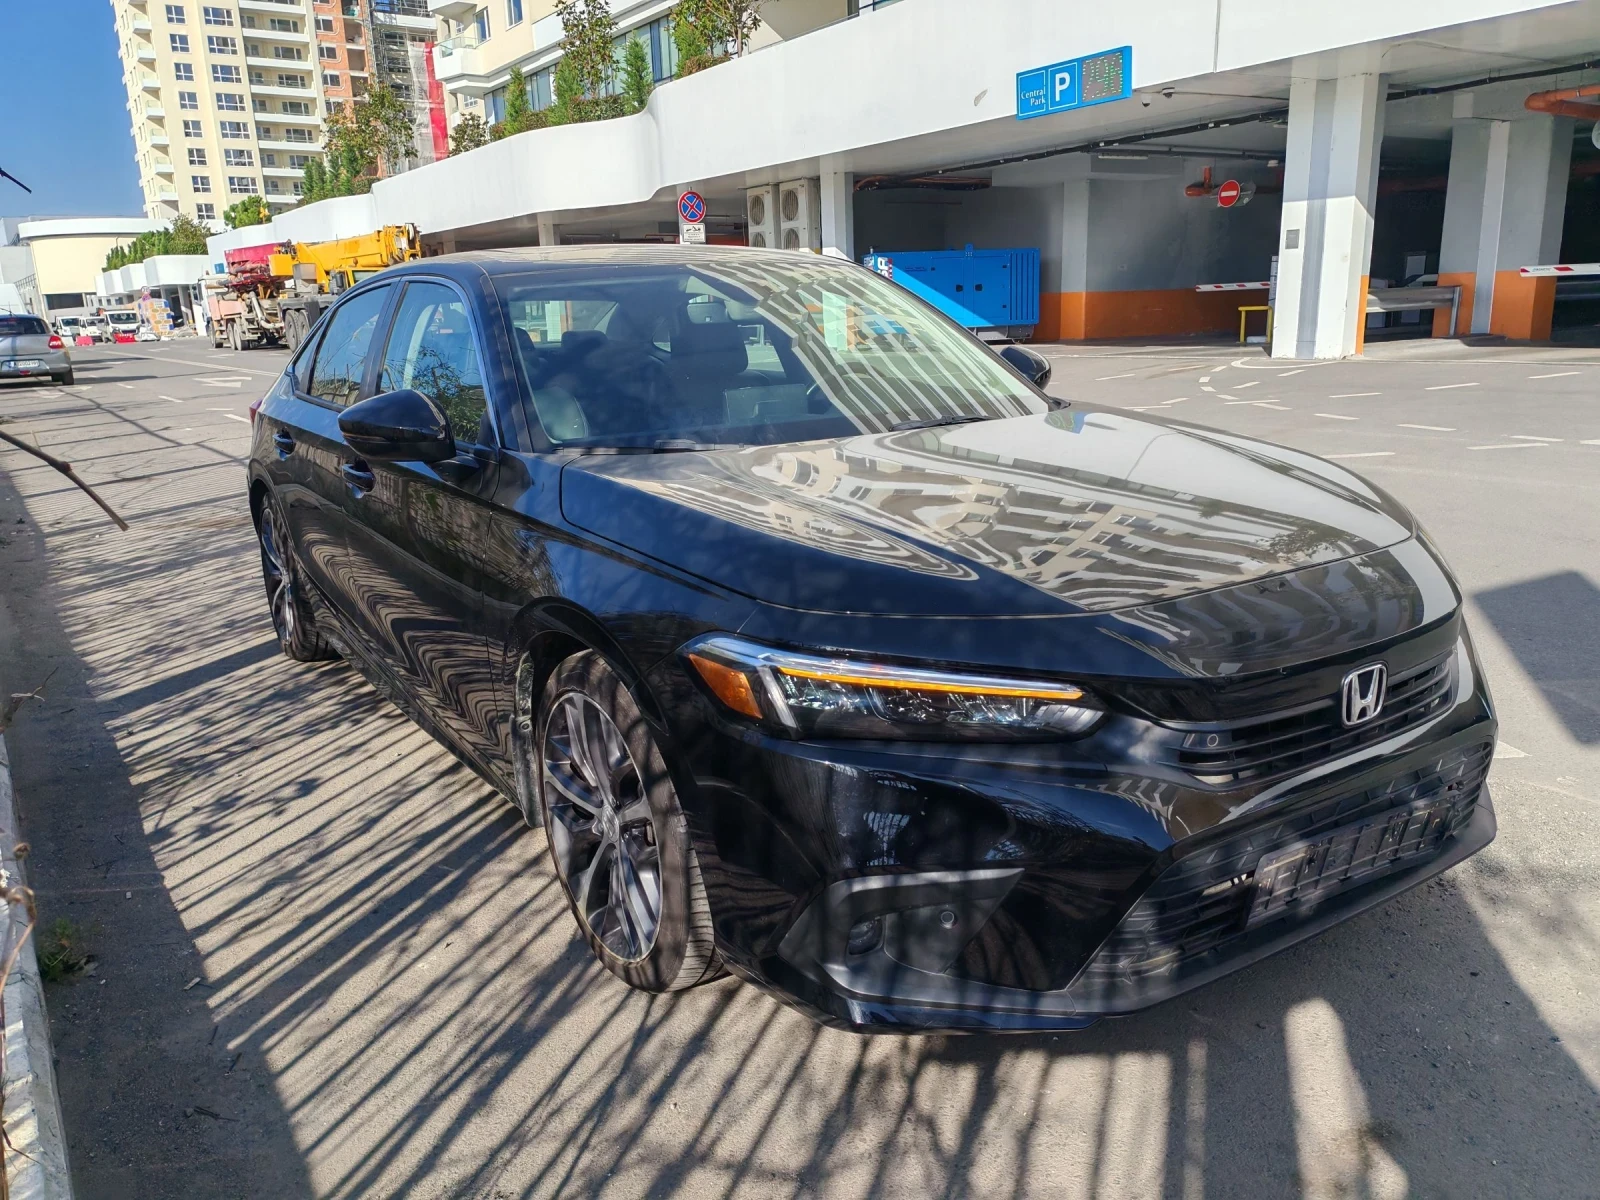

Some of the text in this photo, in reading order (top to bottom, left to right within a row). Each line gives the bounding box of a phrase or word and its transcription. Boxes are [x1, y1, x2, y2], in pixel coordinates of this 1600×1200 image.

[1020, 87, 1046, 99] Central
[1055, 72, 1071, 102] P
[1030, 95, 1046, 106] Park
